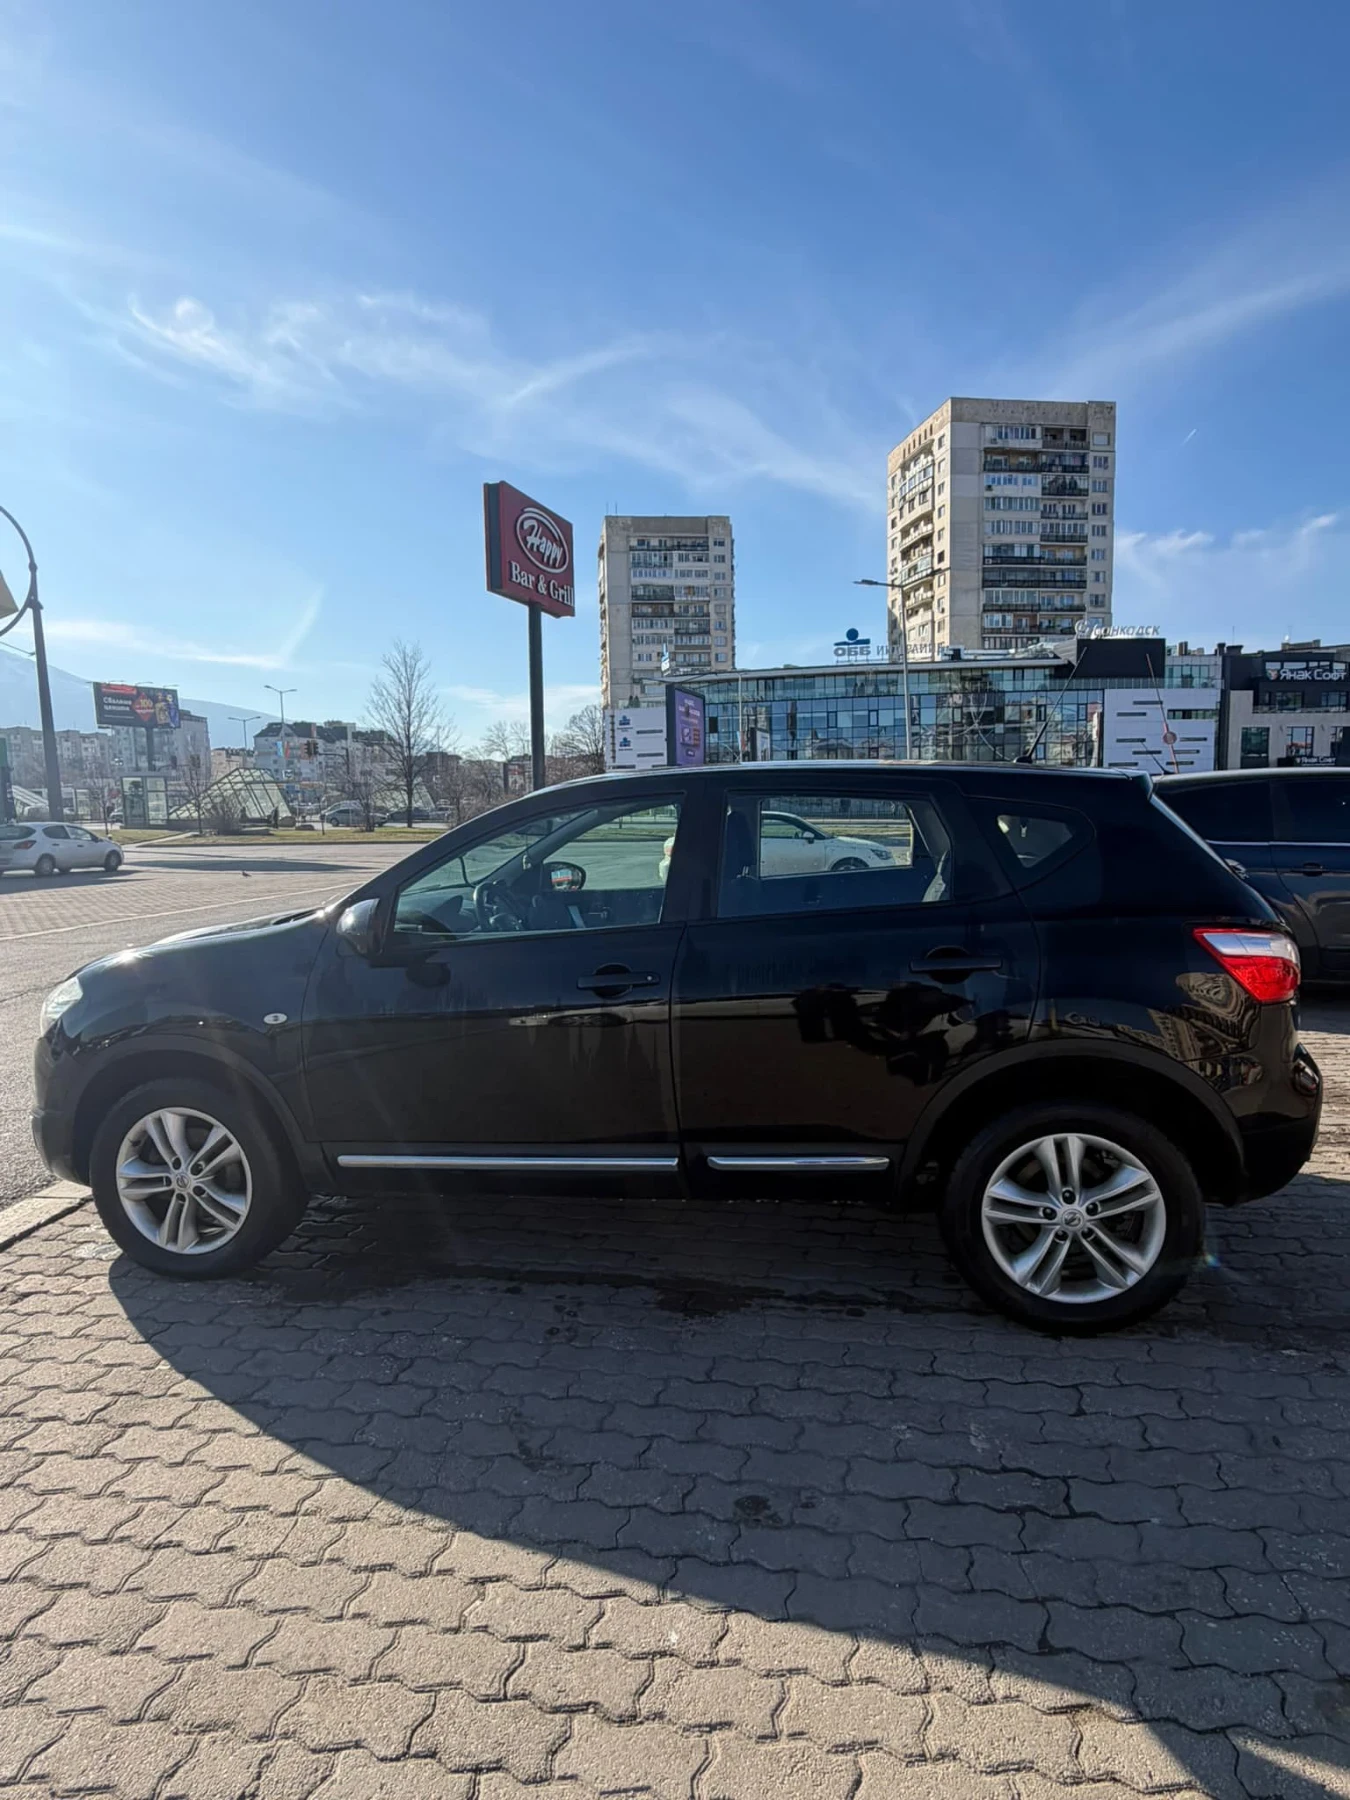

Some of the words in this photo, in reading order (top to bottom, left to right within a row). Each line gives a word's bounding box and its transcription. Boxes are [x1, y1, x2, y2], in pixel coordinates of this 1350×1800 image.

[522, 519, 563, 567] Happy
[510, 562, 535, 589] Bar
[537, 575, 547, 595] &
[550, 580, 574, 606] Grill
[833, 646, 871, 657] ОББ
[1279, 669, 1312, 681] Янак
[1314, 668, 1347, 681] Софт
